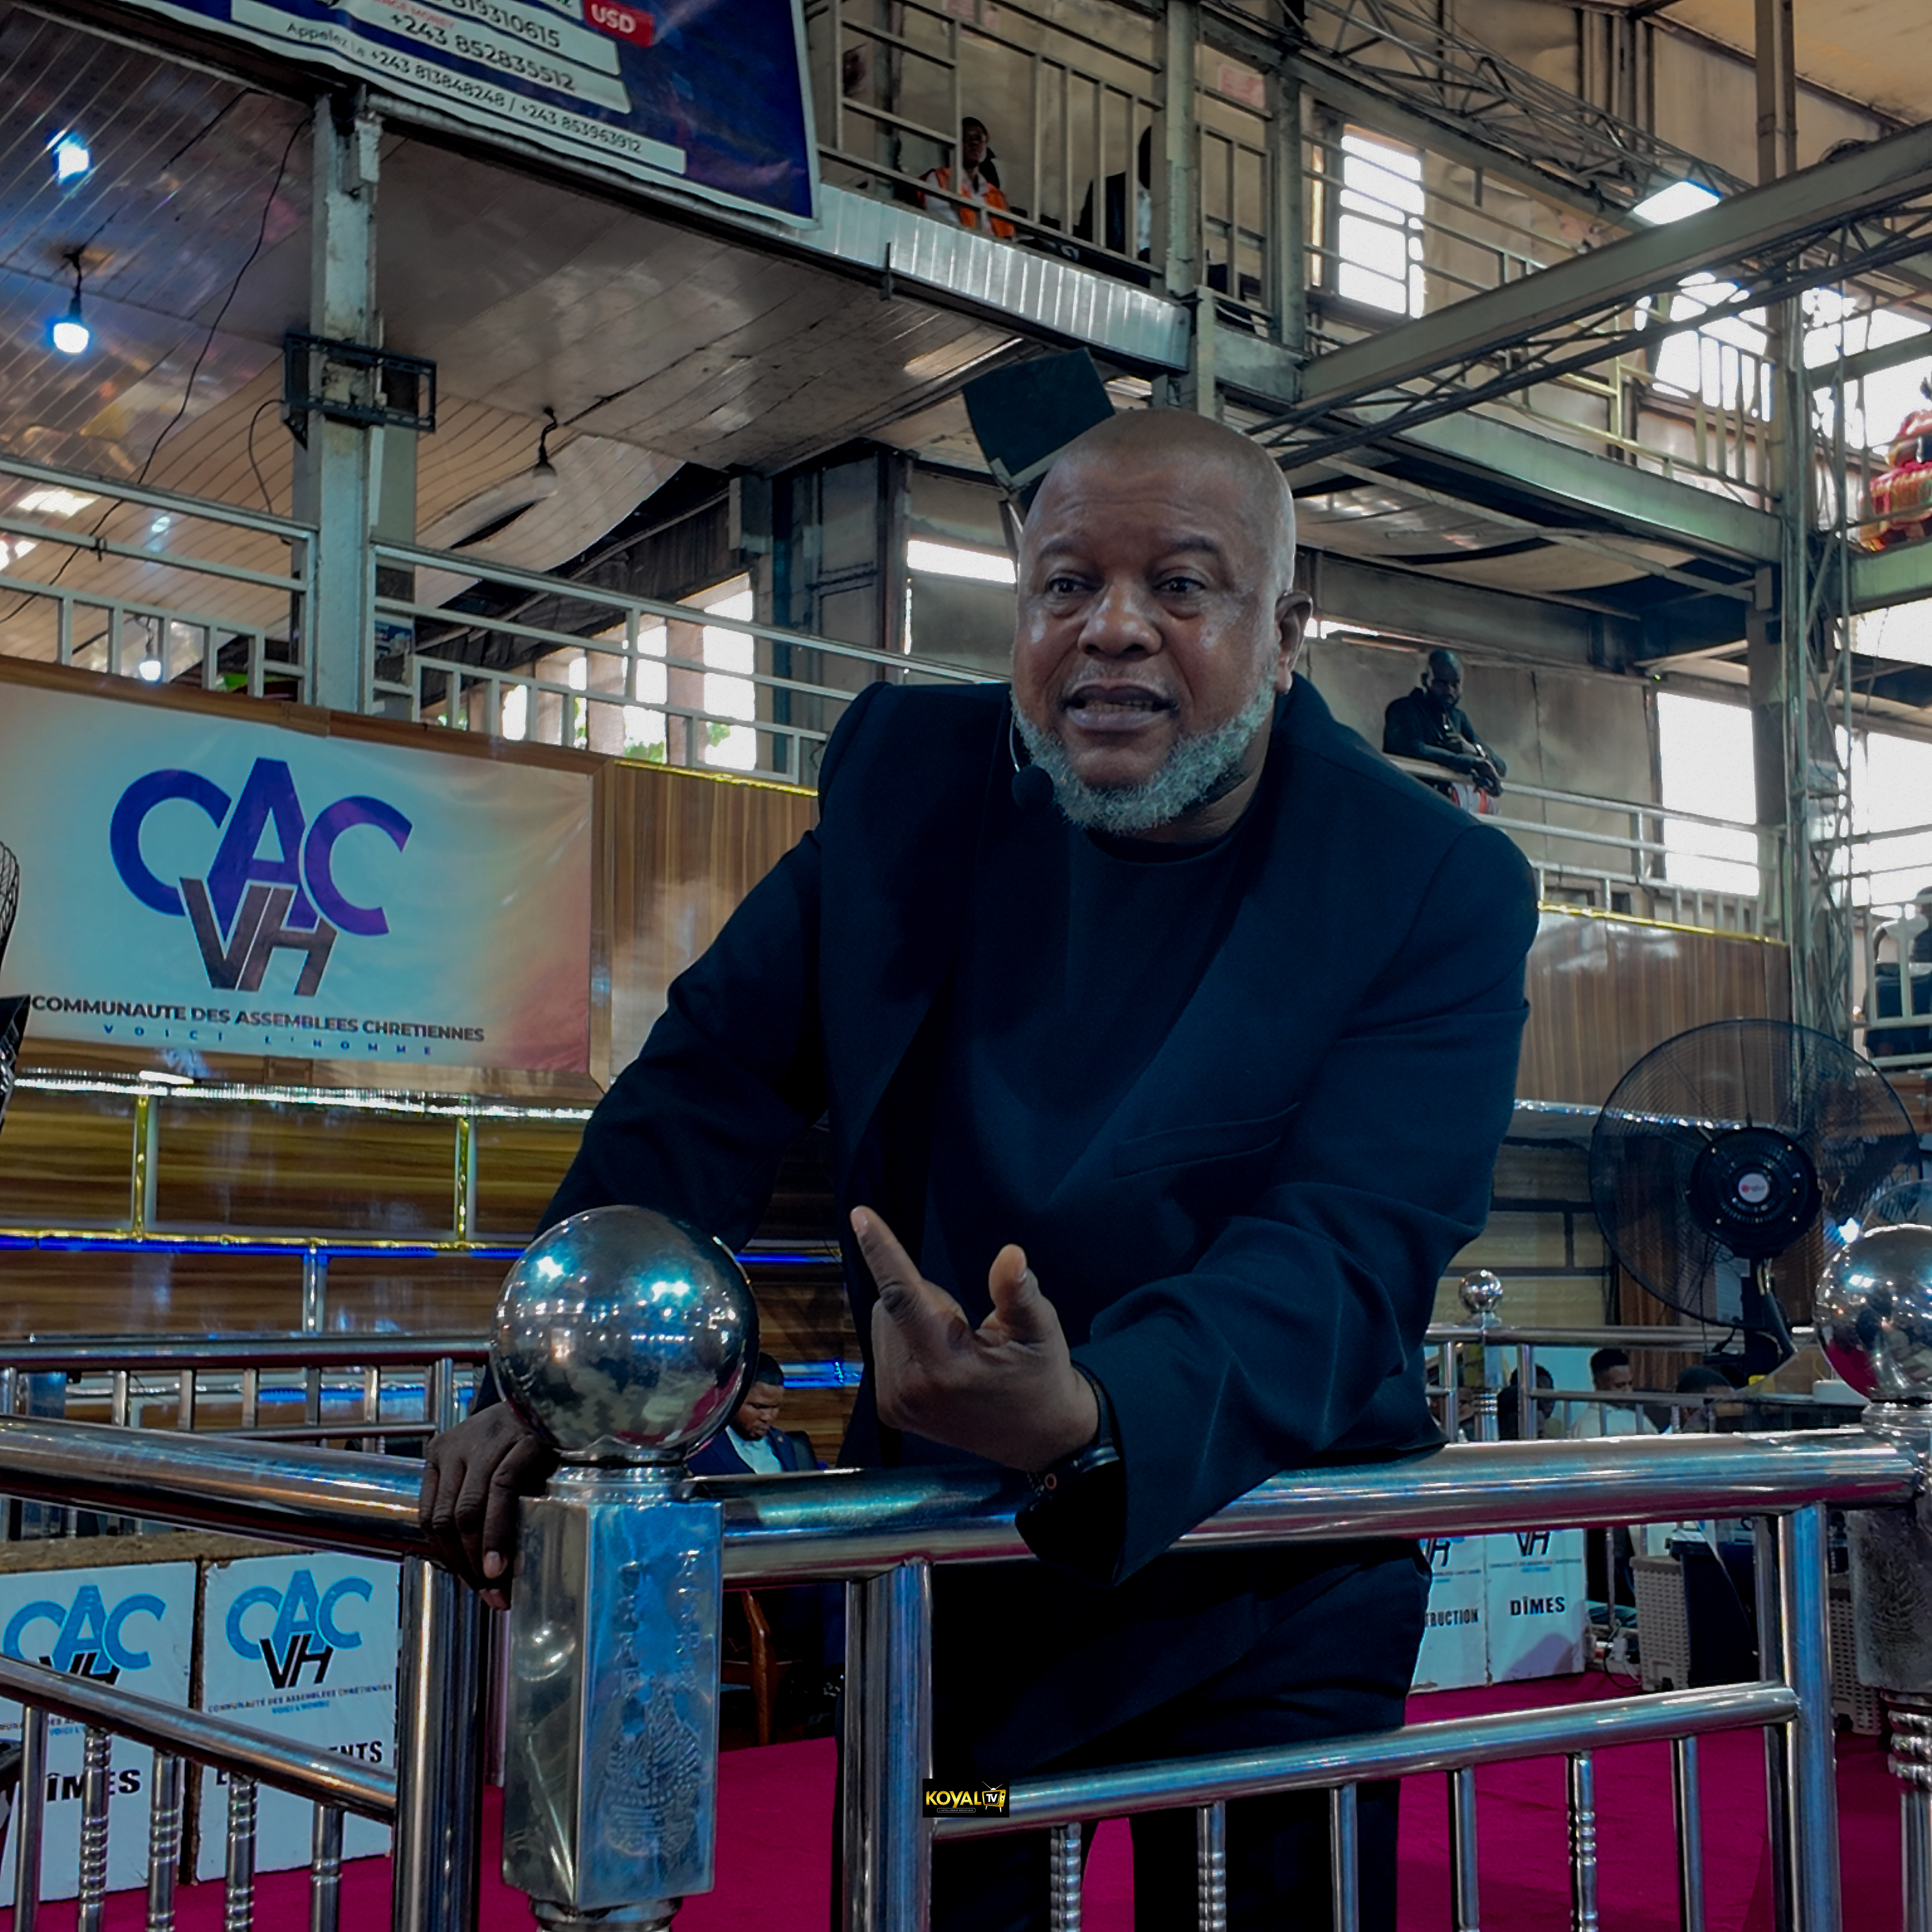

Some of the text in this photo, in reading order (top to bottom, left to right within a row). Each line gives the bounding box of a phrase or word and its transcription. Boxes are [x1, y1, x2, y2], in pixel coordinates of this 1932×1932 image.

[391, 14, 577, 93] +243 852835512
[591, 4, 636, 34] USD
[371, 50, 410, 74] +243
[414, 64, 505, 108] 813848248
[521, 104, 557, 126] +243
[109, 757, 413, 936] CAC
[179, 877, 338, 997] VH
[31, 994, 485, 1043] COMMUNAUTE DES ASSEMBLEES CHRETIENNES
[2, 1584, 166, 1671] CAC
[226, 1569, 374, 1660] CAC
[259, 1633, 334, 1690] VH
